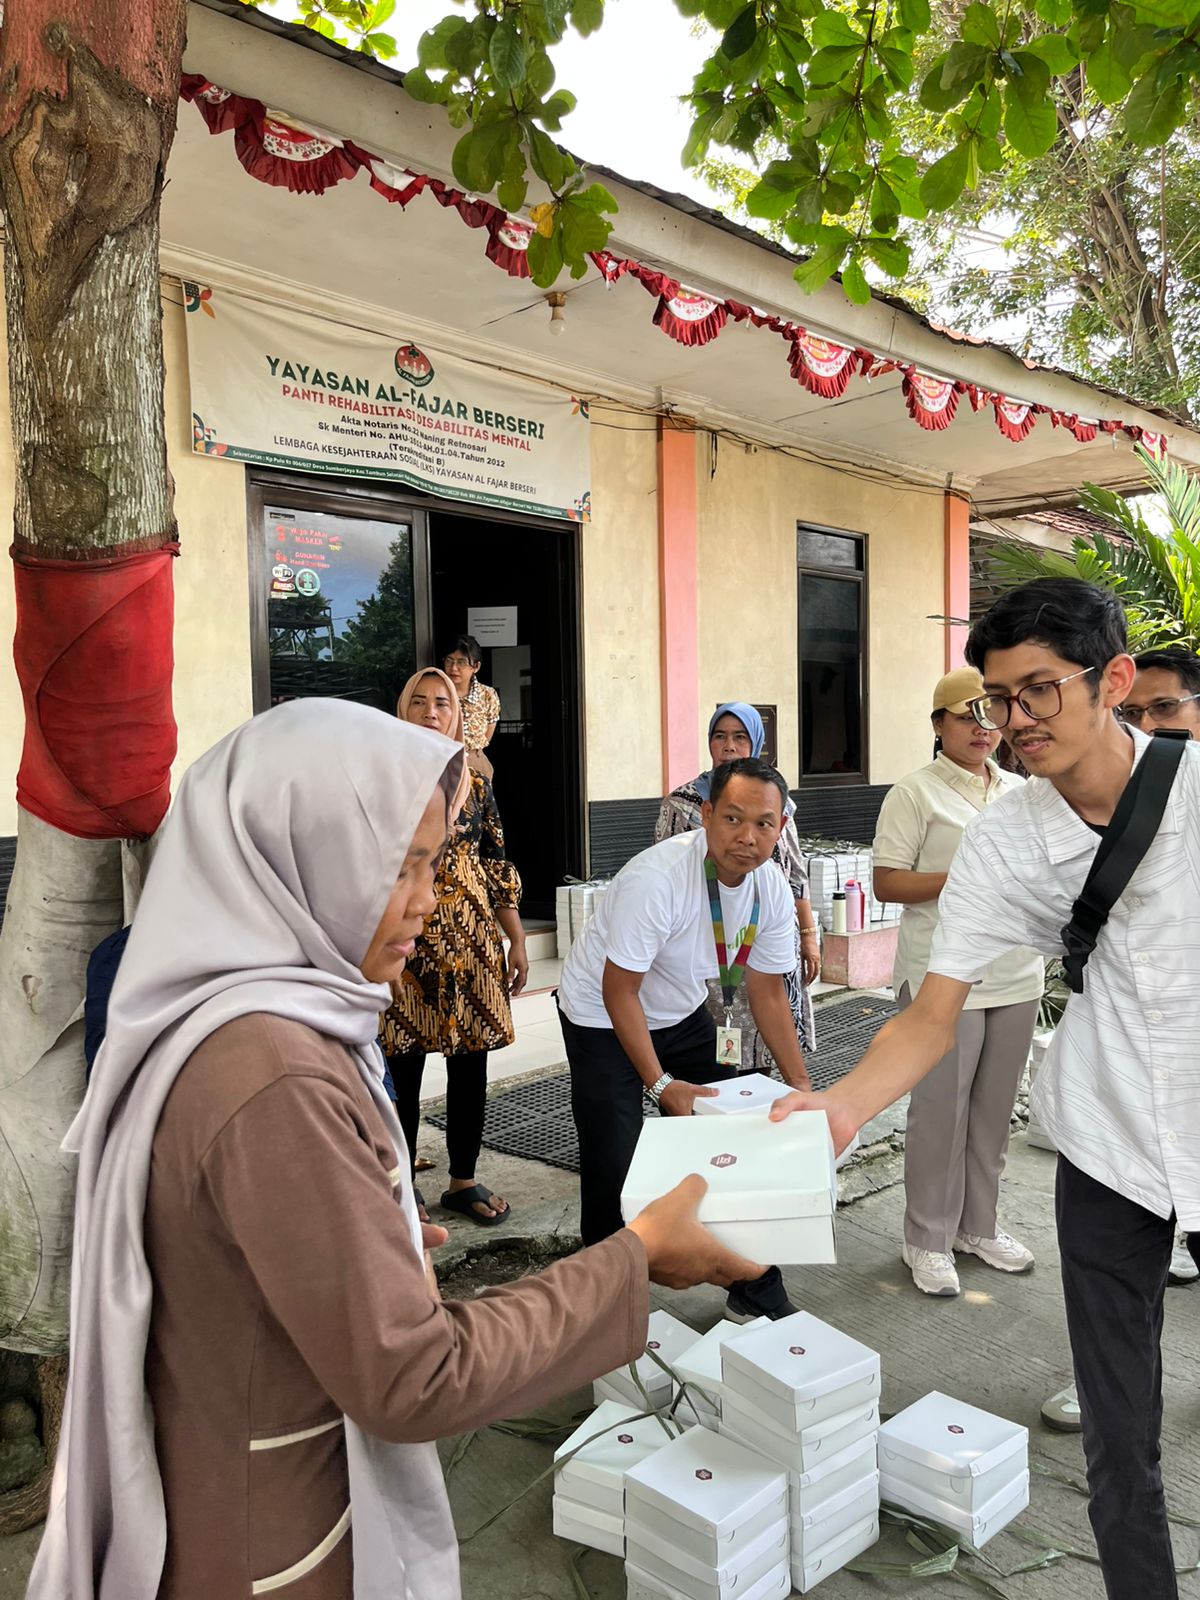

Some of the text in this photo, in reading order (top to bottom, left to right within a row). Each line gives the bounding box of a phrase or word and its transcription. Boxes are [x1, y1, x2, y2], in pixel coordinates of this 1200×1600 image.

[265, 354, 369, 397] YAYASAN
[375, 383, 468, 420] AL-FAJAR
[473, 407, 544, 440] BERSERI
[282, 384, 531, 451] PANTI REHABILITASI DISABILITAS MENTAL
[318, 421, 329, 431] Sk
[332, 424, 367, 438] Menteri
[487, 457, 505, 468] 2012
[340, 415, 361, 426] Akta
[364, 420, 399, 431] Notaris
[448, 439, 487, 453] Retnosari
[273, 435, 319, 452] LEMBAGA
[321, 445, 397, 461] KESEJAHTERAAN
[399, 454, 420, 468] SOSIAL
[436, 467, 474, 483] YAYASAN
[475, 475, 486, 484] AL
[487, 477, 508, 489] FAJAR
[510, 482, 537, 495] BERSERI
[436, 458, 445, 467] B)
